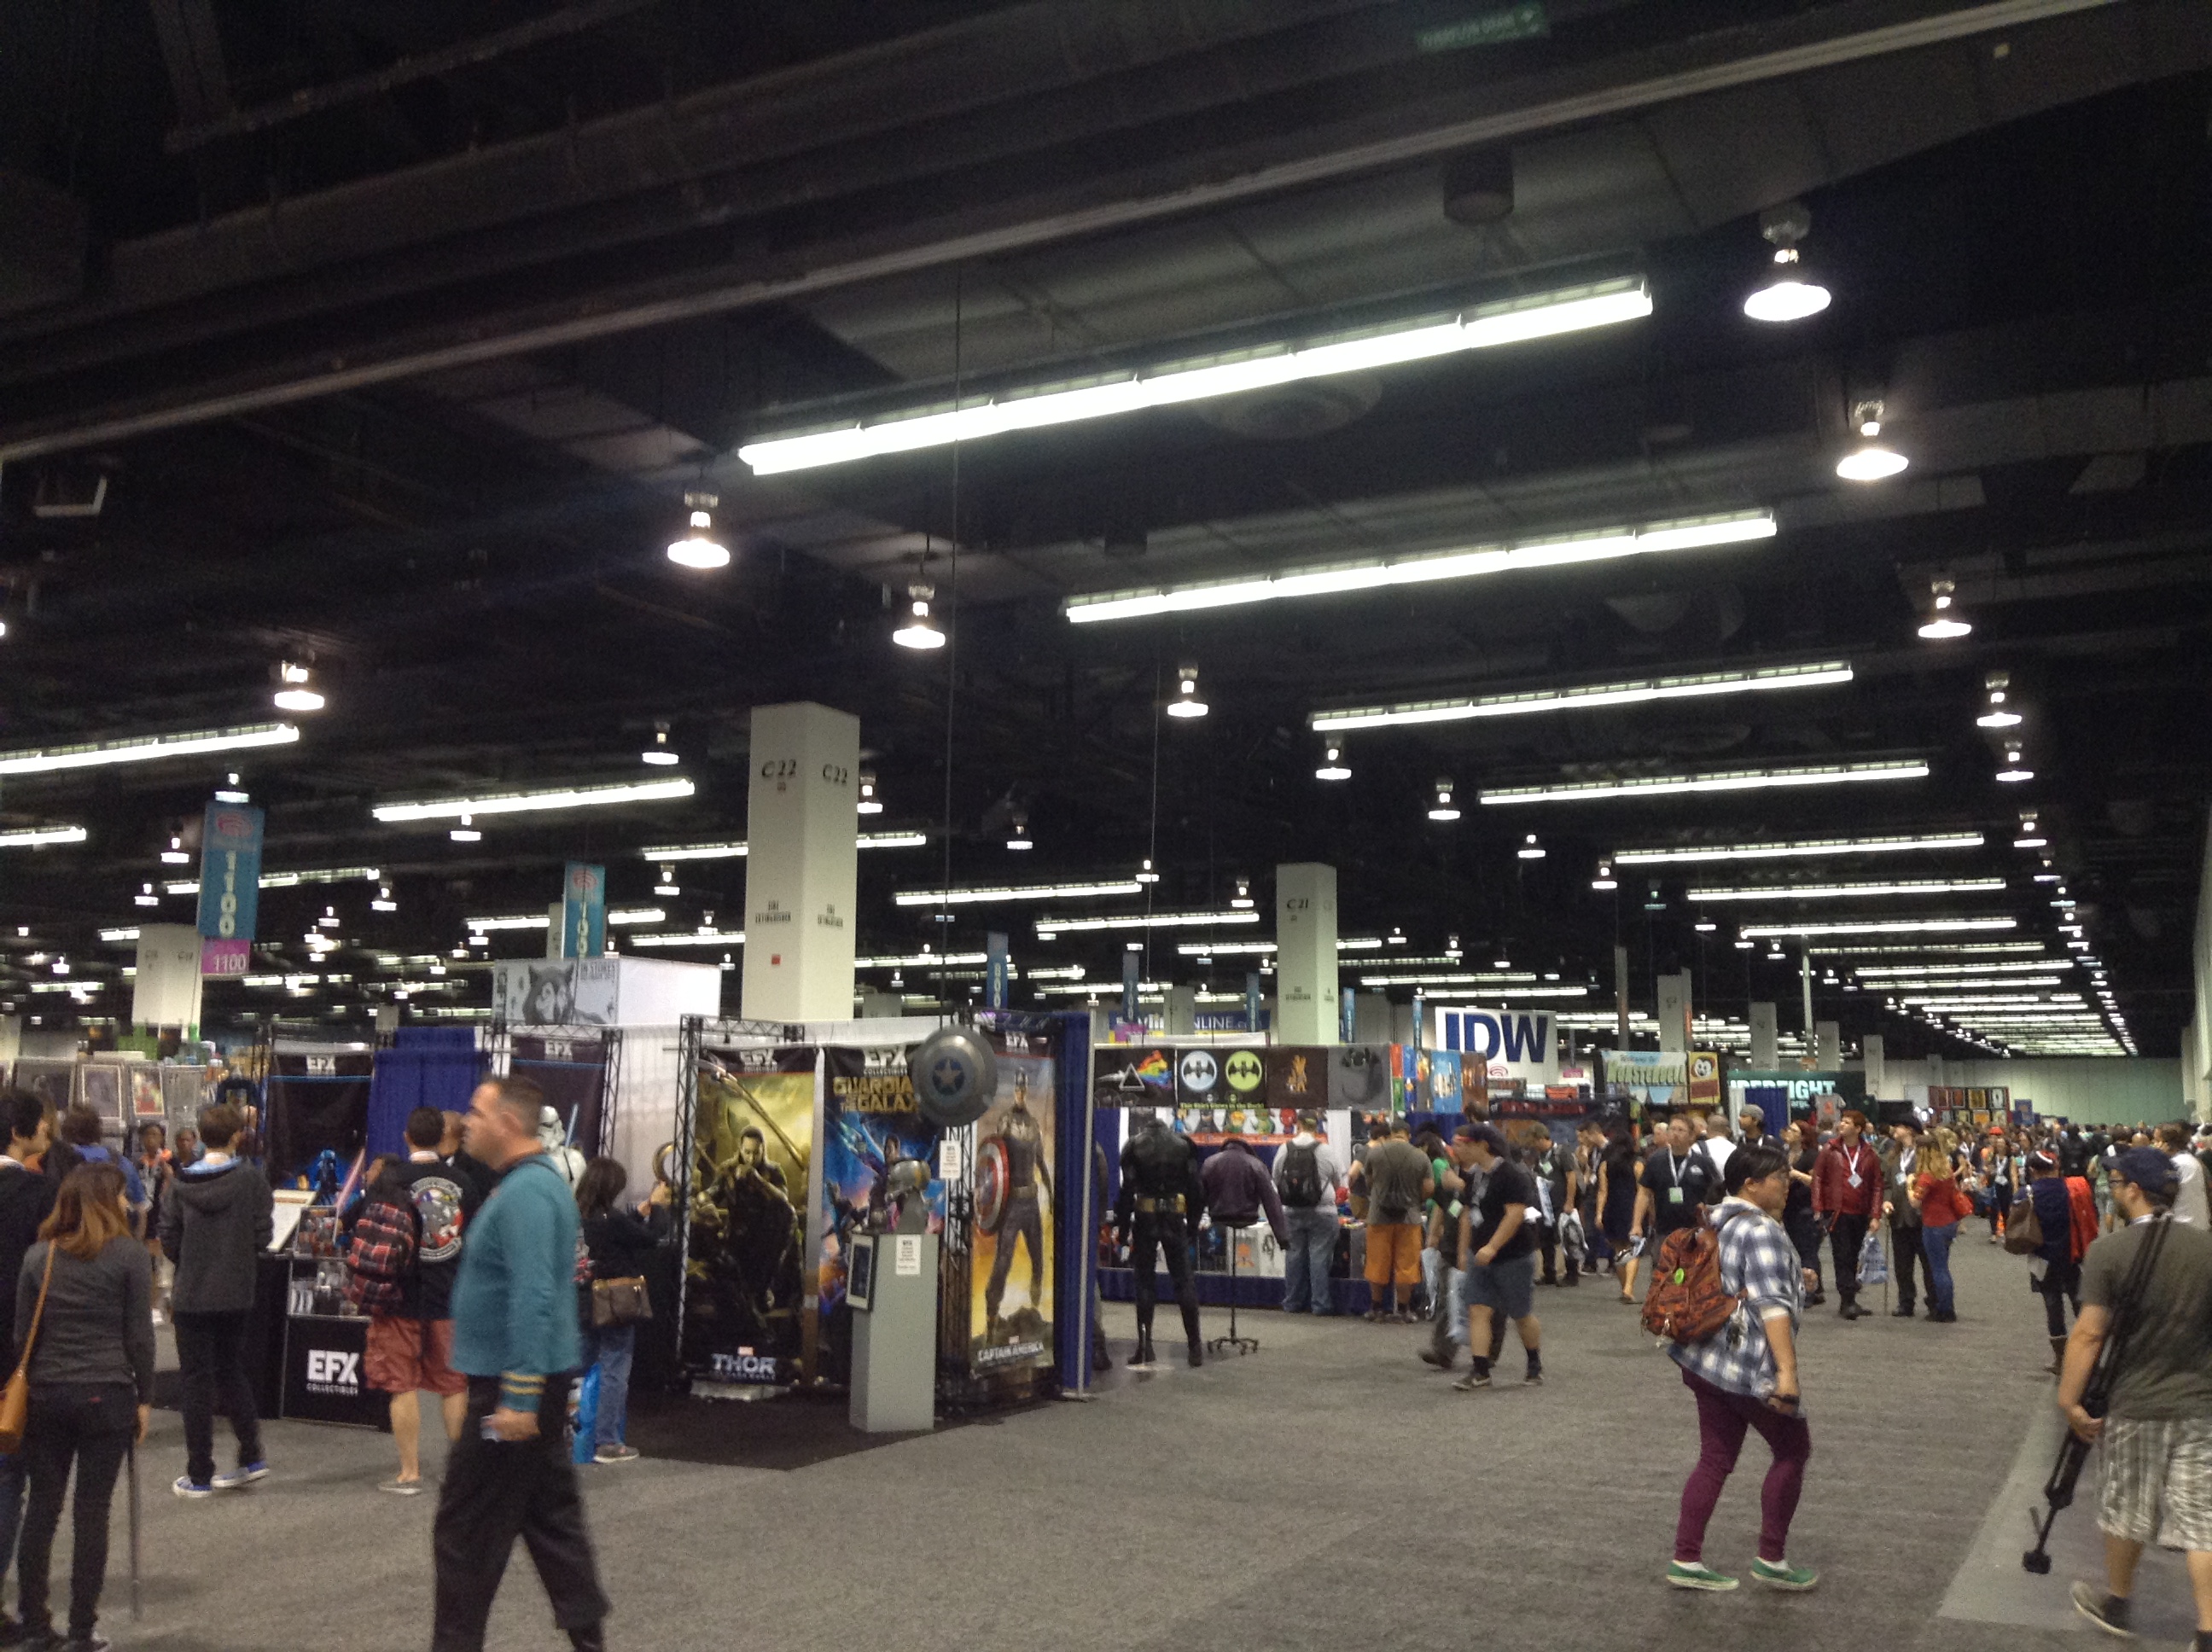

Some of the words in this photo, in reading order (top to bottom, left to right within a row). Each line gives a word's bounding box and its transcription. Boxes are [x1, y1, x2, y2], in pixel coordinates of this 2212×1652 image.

[222, 849, 237, 938] 1100
[213, 953, 247, 972] 1100
[1446, 1013, 1548, 1063] IDW
[863, 1045, 908, 1067] EFX
[308, 1349, 359, 1384] EFX
[711, 1353, 777, 1373] THOR
